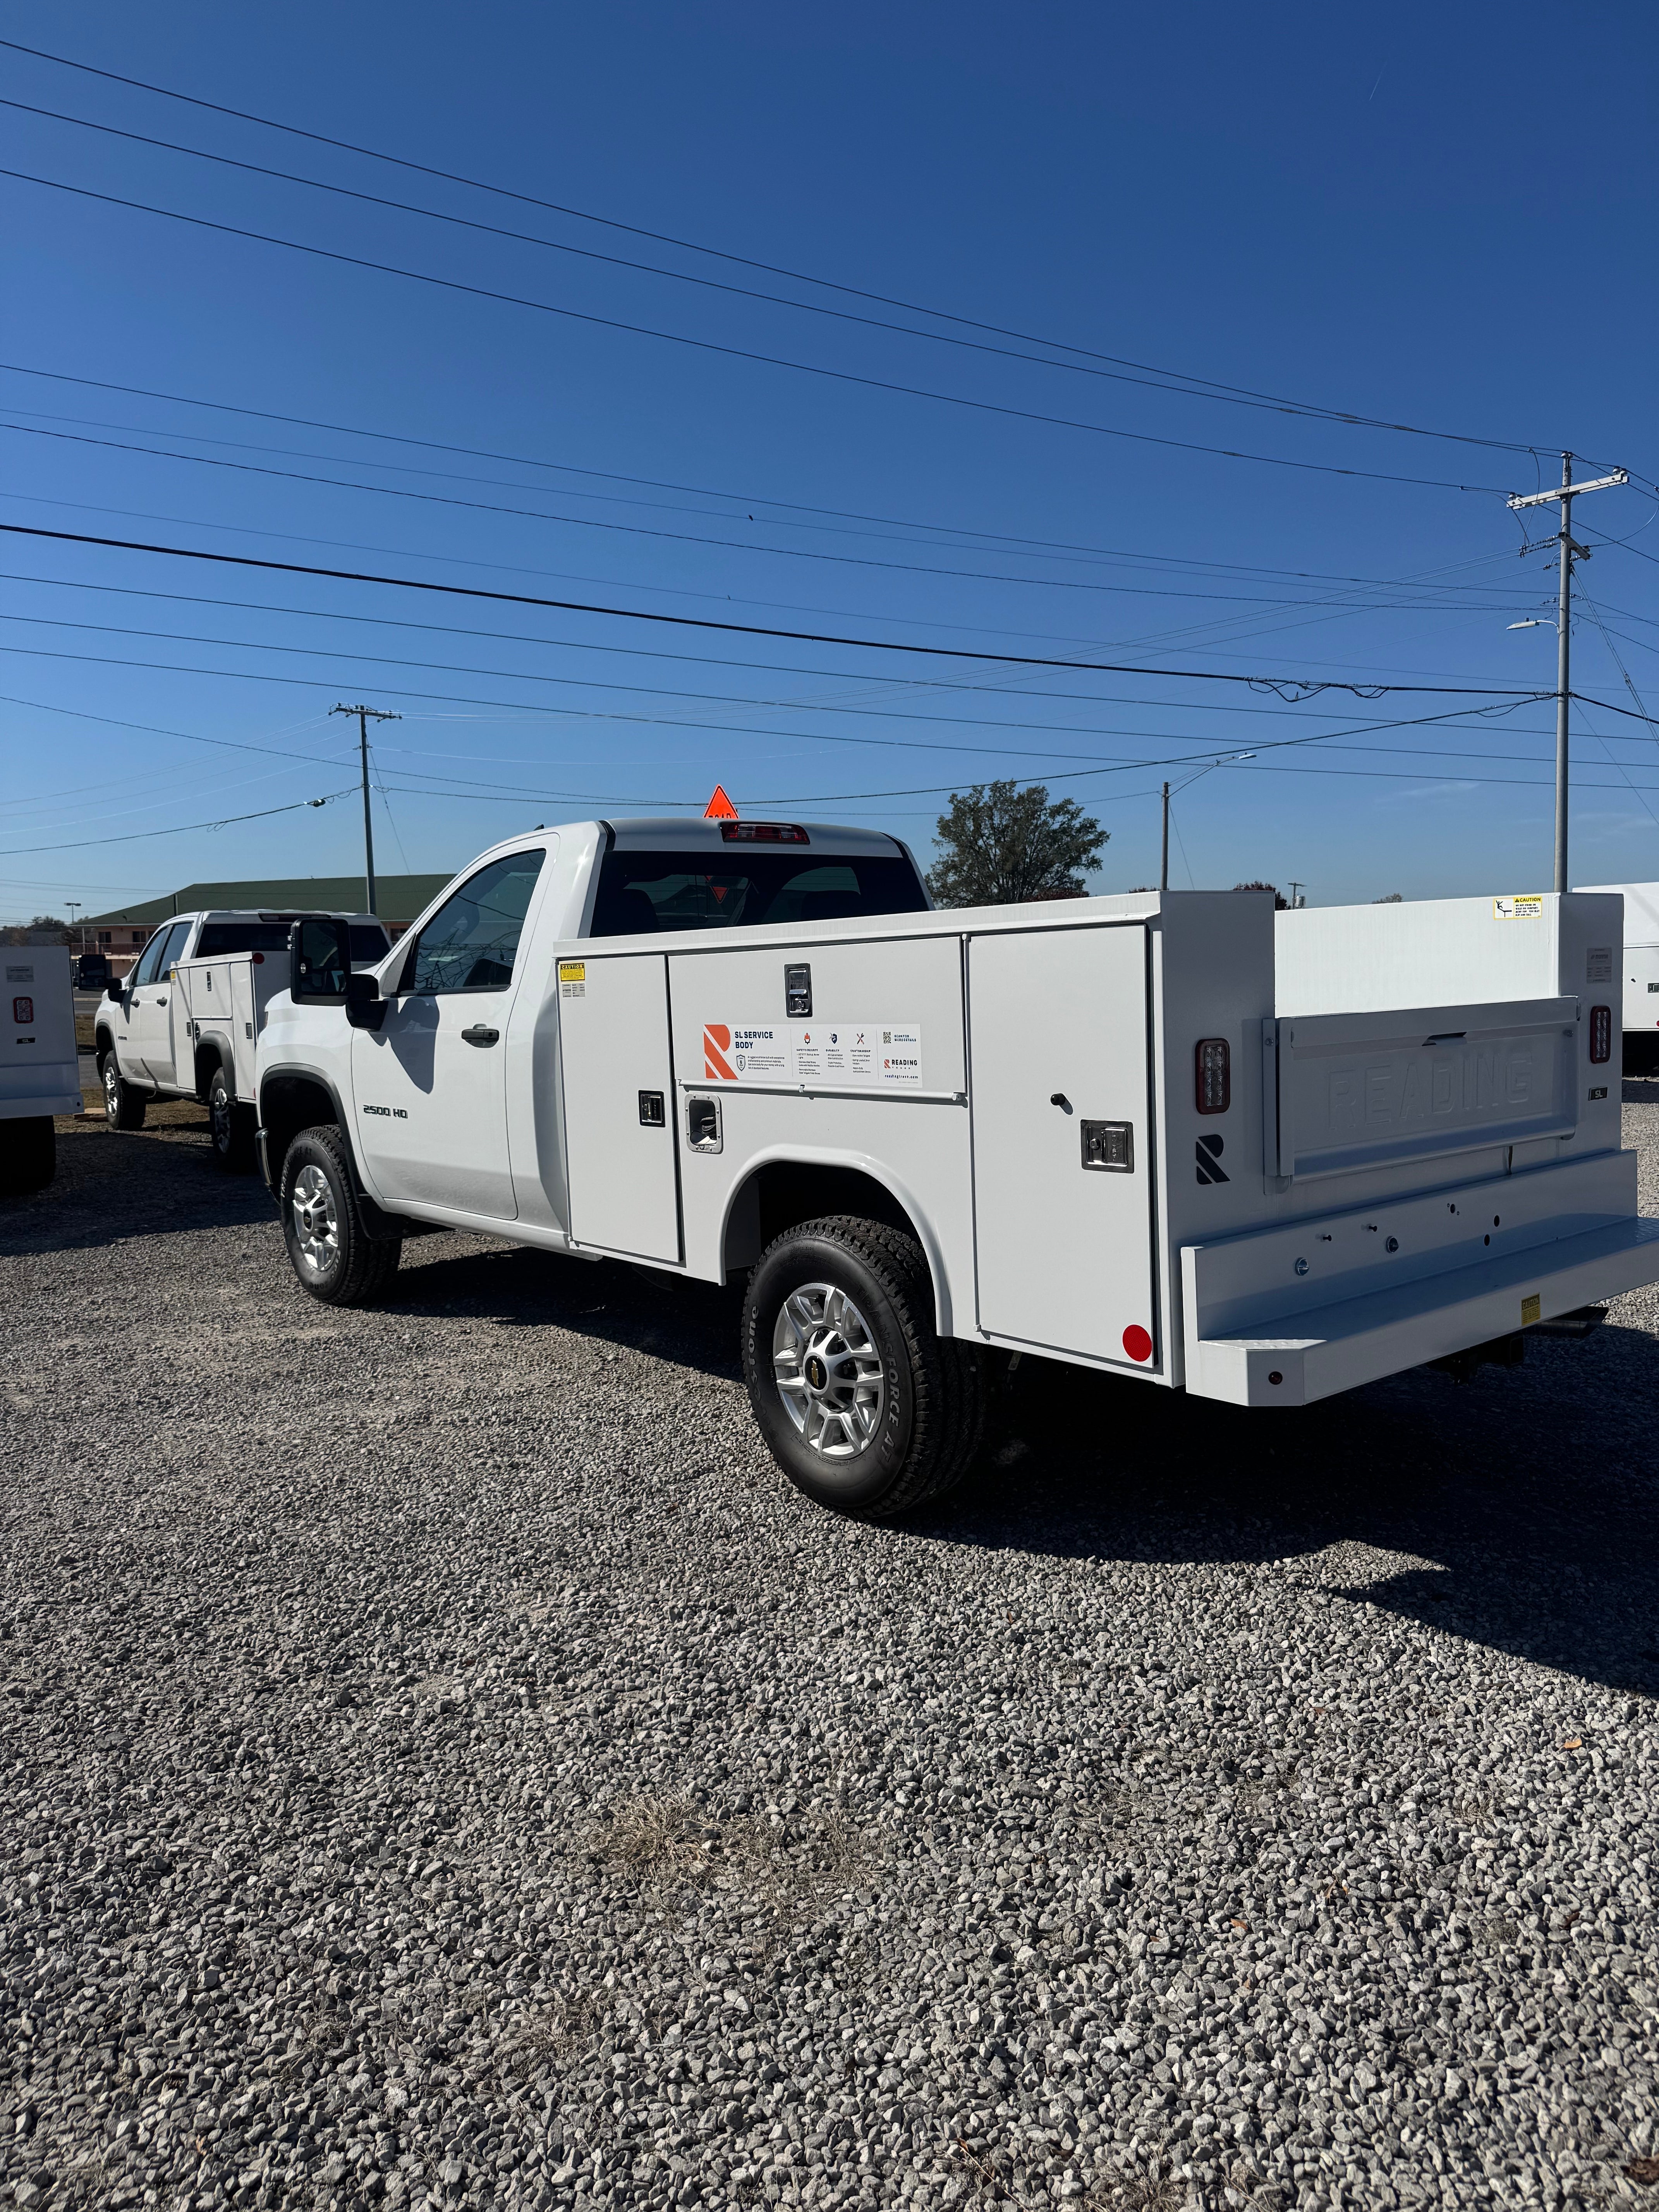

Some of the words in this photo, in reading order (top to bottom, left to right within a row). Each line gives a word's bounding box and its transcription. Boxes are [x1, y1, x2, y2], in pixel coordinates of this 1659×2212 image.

[1328, 1050, 1533, 1130] READING
[1595, 1089, 1603, 1098] SL
[363, 1104, 391, 1116] 2500
[393, 1108, 408, 1119] HD
[1522, 1297, 1539, 1309] CAUTION
[856, 1284, 901, 1427] TRANSFORCE
[882, 1431, 895, 1463] AT
